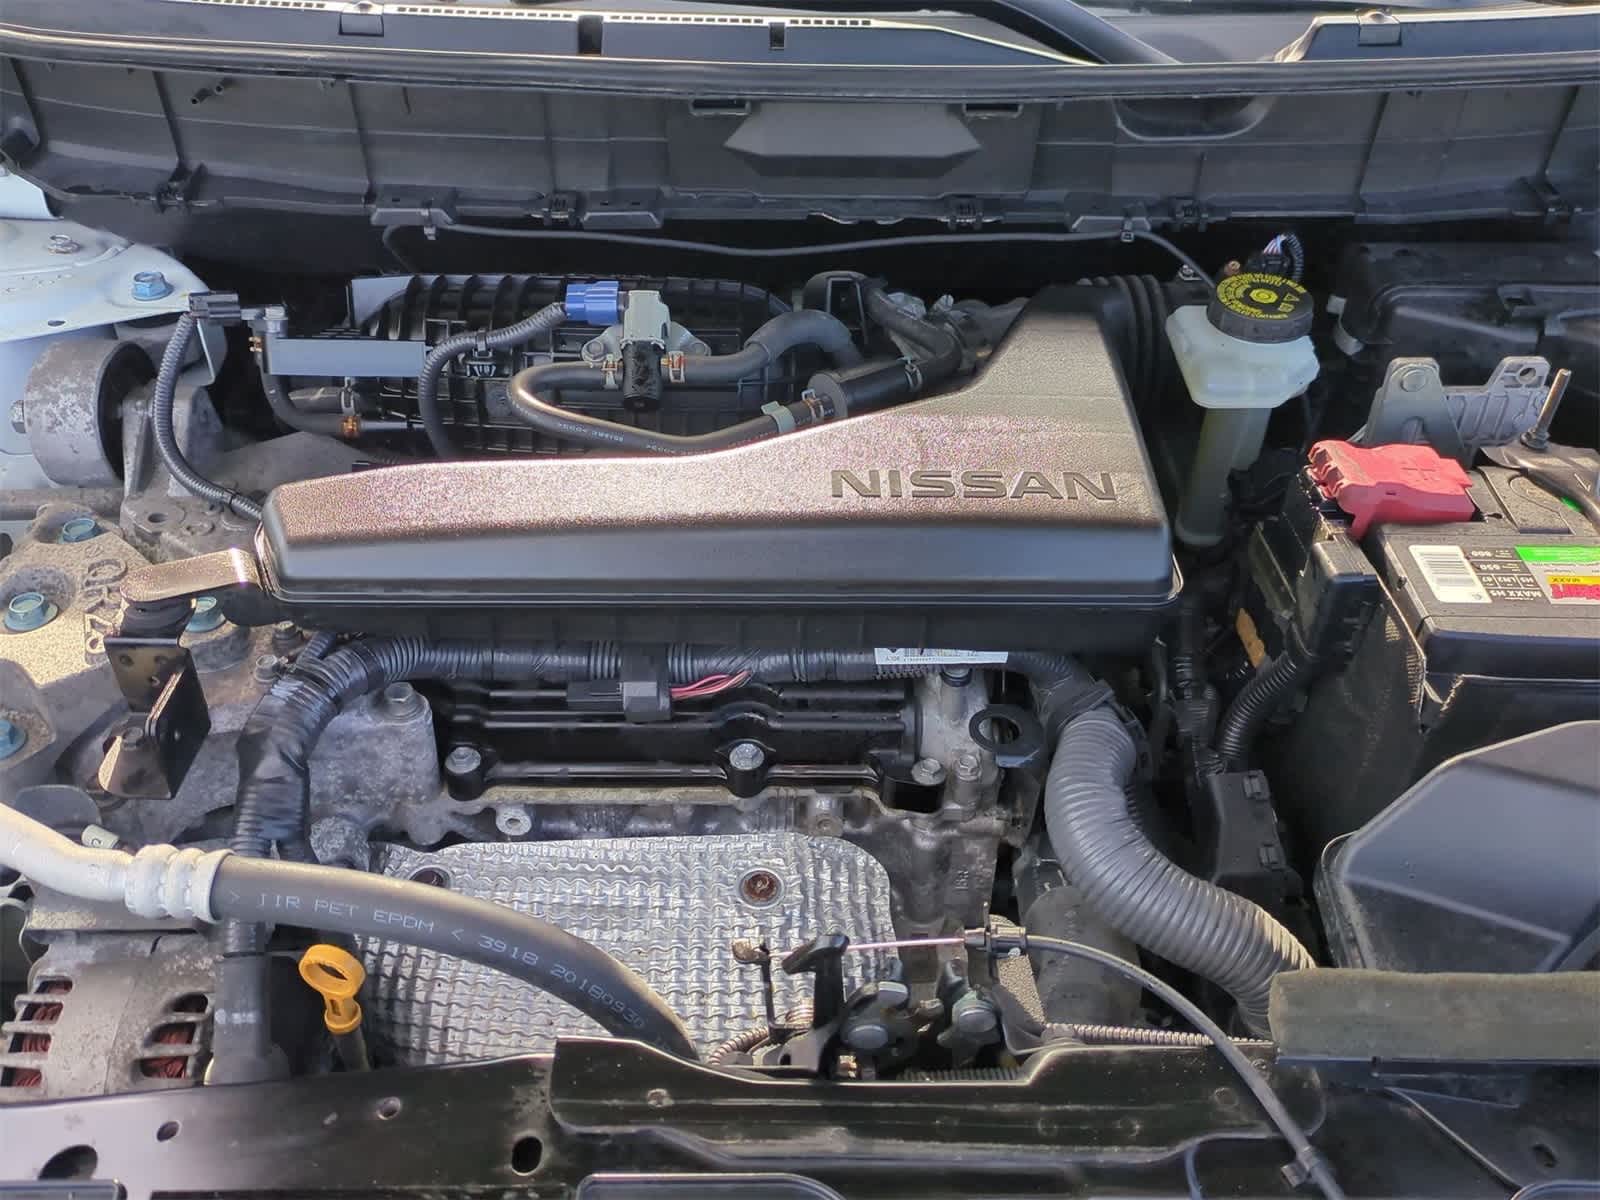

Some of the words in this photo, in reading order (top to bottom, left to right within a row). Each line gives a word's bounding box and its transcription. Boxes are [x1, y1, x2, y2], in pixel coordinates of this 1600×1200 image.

[831, 469, 1117, 501] NISSAN
[1507, 590, 1542, 598] MAXX
[314, 896, 360, 918] PET
[372, 909, 435, 933] EPDM
[479, 935, 540, 966] 3918
[550, 963, 646, 1030] 20180930
